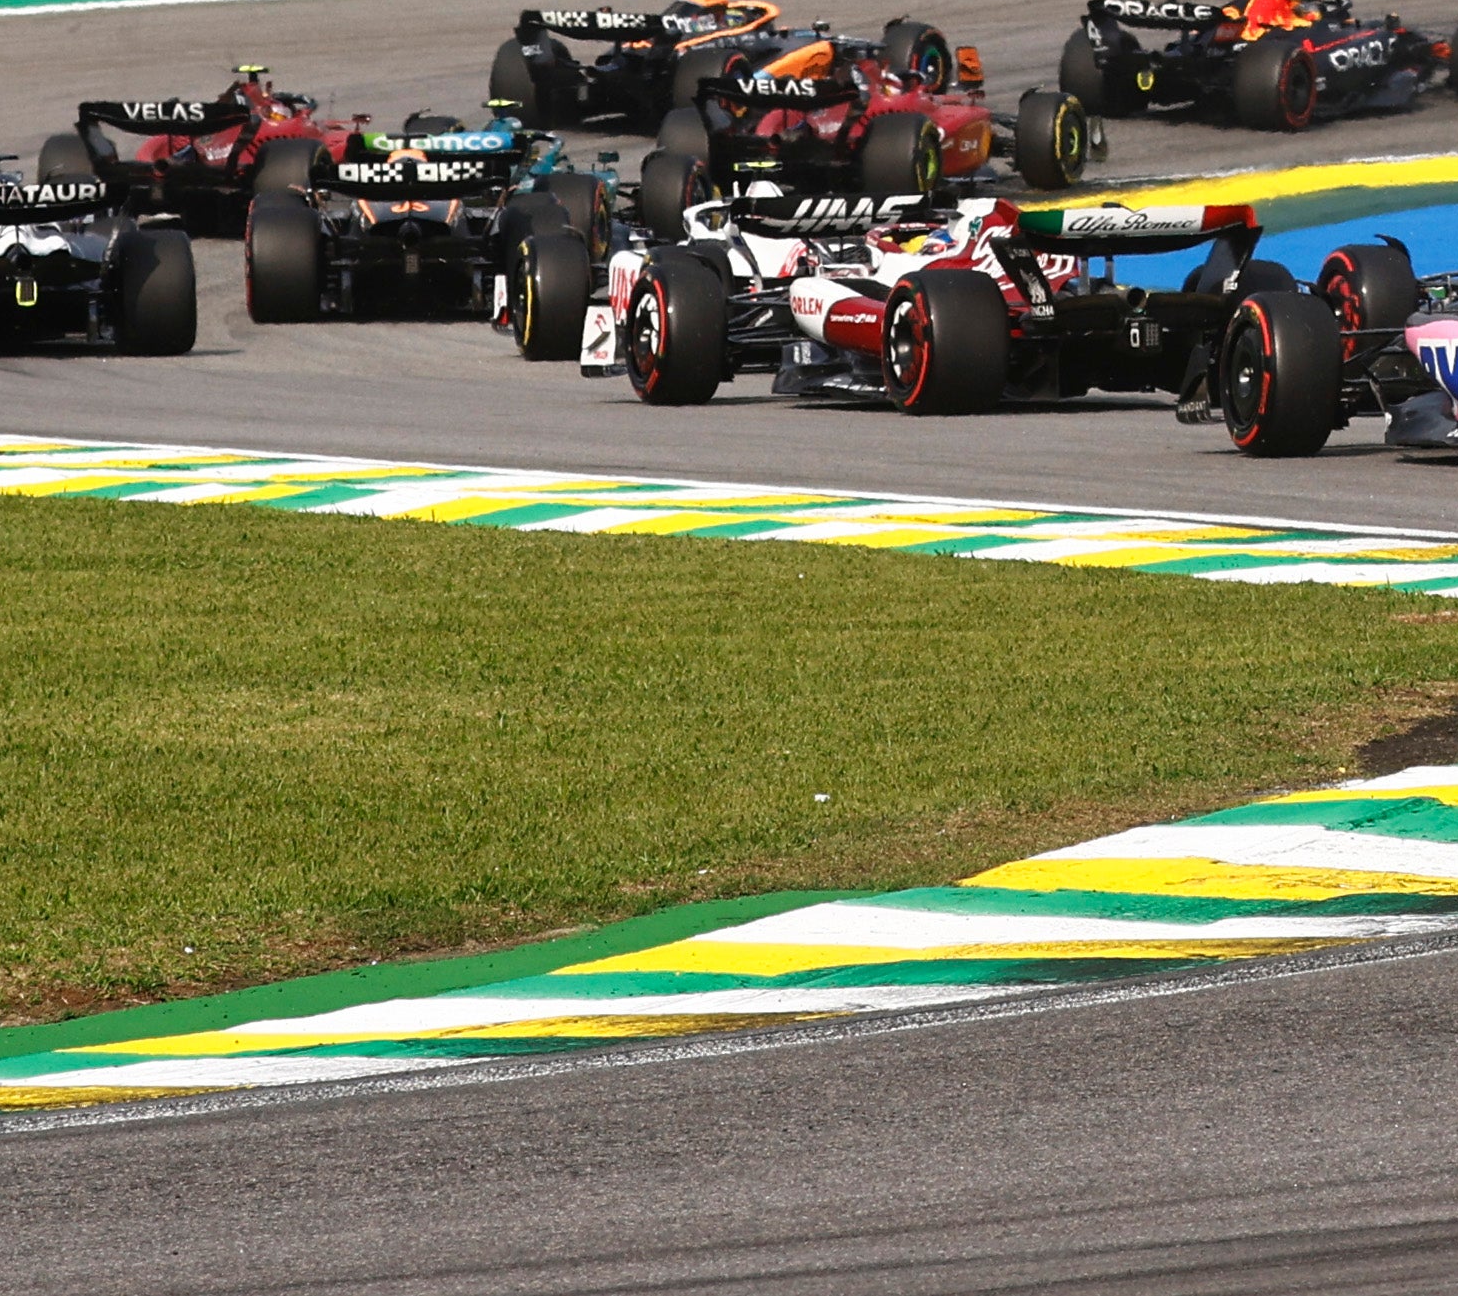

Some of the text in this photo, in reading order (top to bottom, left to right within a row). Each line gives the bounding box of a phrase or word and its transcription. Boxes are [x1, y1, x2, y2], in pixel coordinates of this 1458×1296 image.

[738, 78, 817, 98] VELAS
[123, 101, 205, 122] VELAS
[338, 162, 484, 183] OKX OKX
[764, 194, 924, 235] HAAS
[1068, 212, 1195, 235] Alfa Romeo
